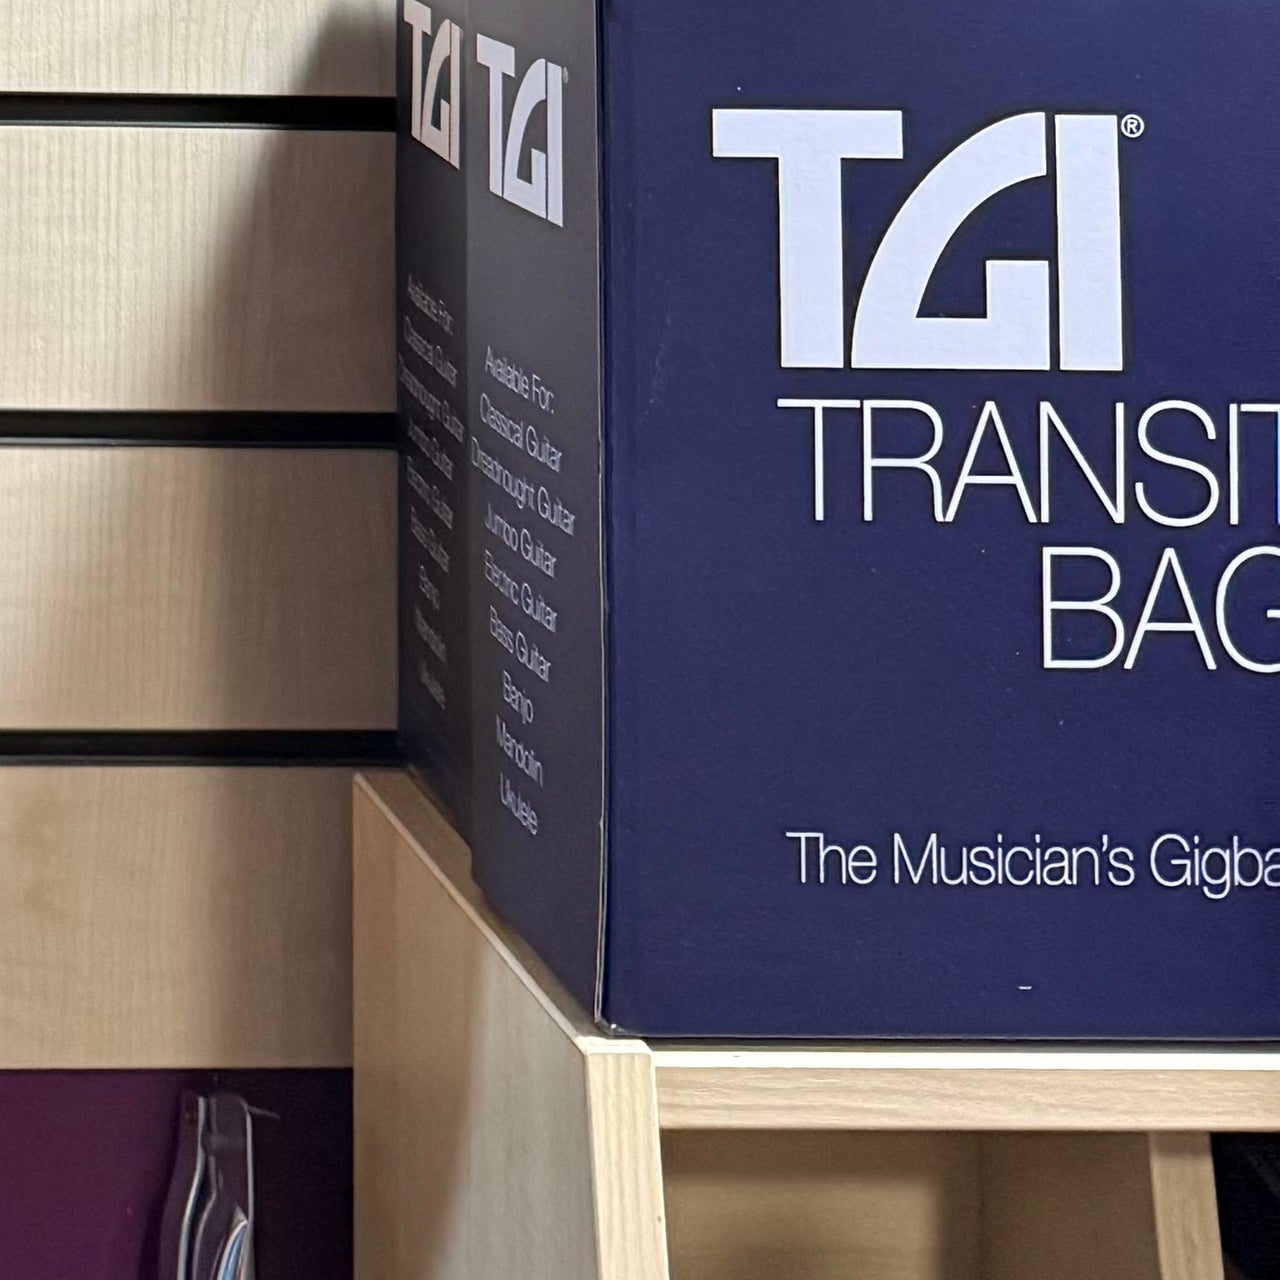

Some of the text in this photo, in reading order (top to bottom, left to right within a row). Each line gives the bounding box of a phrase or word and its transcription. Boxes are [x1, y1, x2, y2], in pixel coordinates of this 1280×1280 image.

[485, 345, 530, 399] Available
[480, 393, 562, 472] Classical Guitar
[471, 436, 576, 536] Dreadnought Guitar
[520, 528, 556, 578] Guitar
[484, 548, 557, 633] Electric Guitar
[490, 604, 514, 654] Bass
[515, 630, 551, 683] Guitar
[502, 669, 534, 724] Banjo
[496, 714, 543, 788] Mandolin
[500, 772, 538, 836] Ukulele
[786, 830, 877, 884] The
[894, 832, 1135, 886] Musician's
